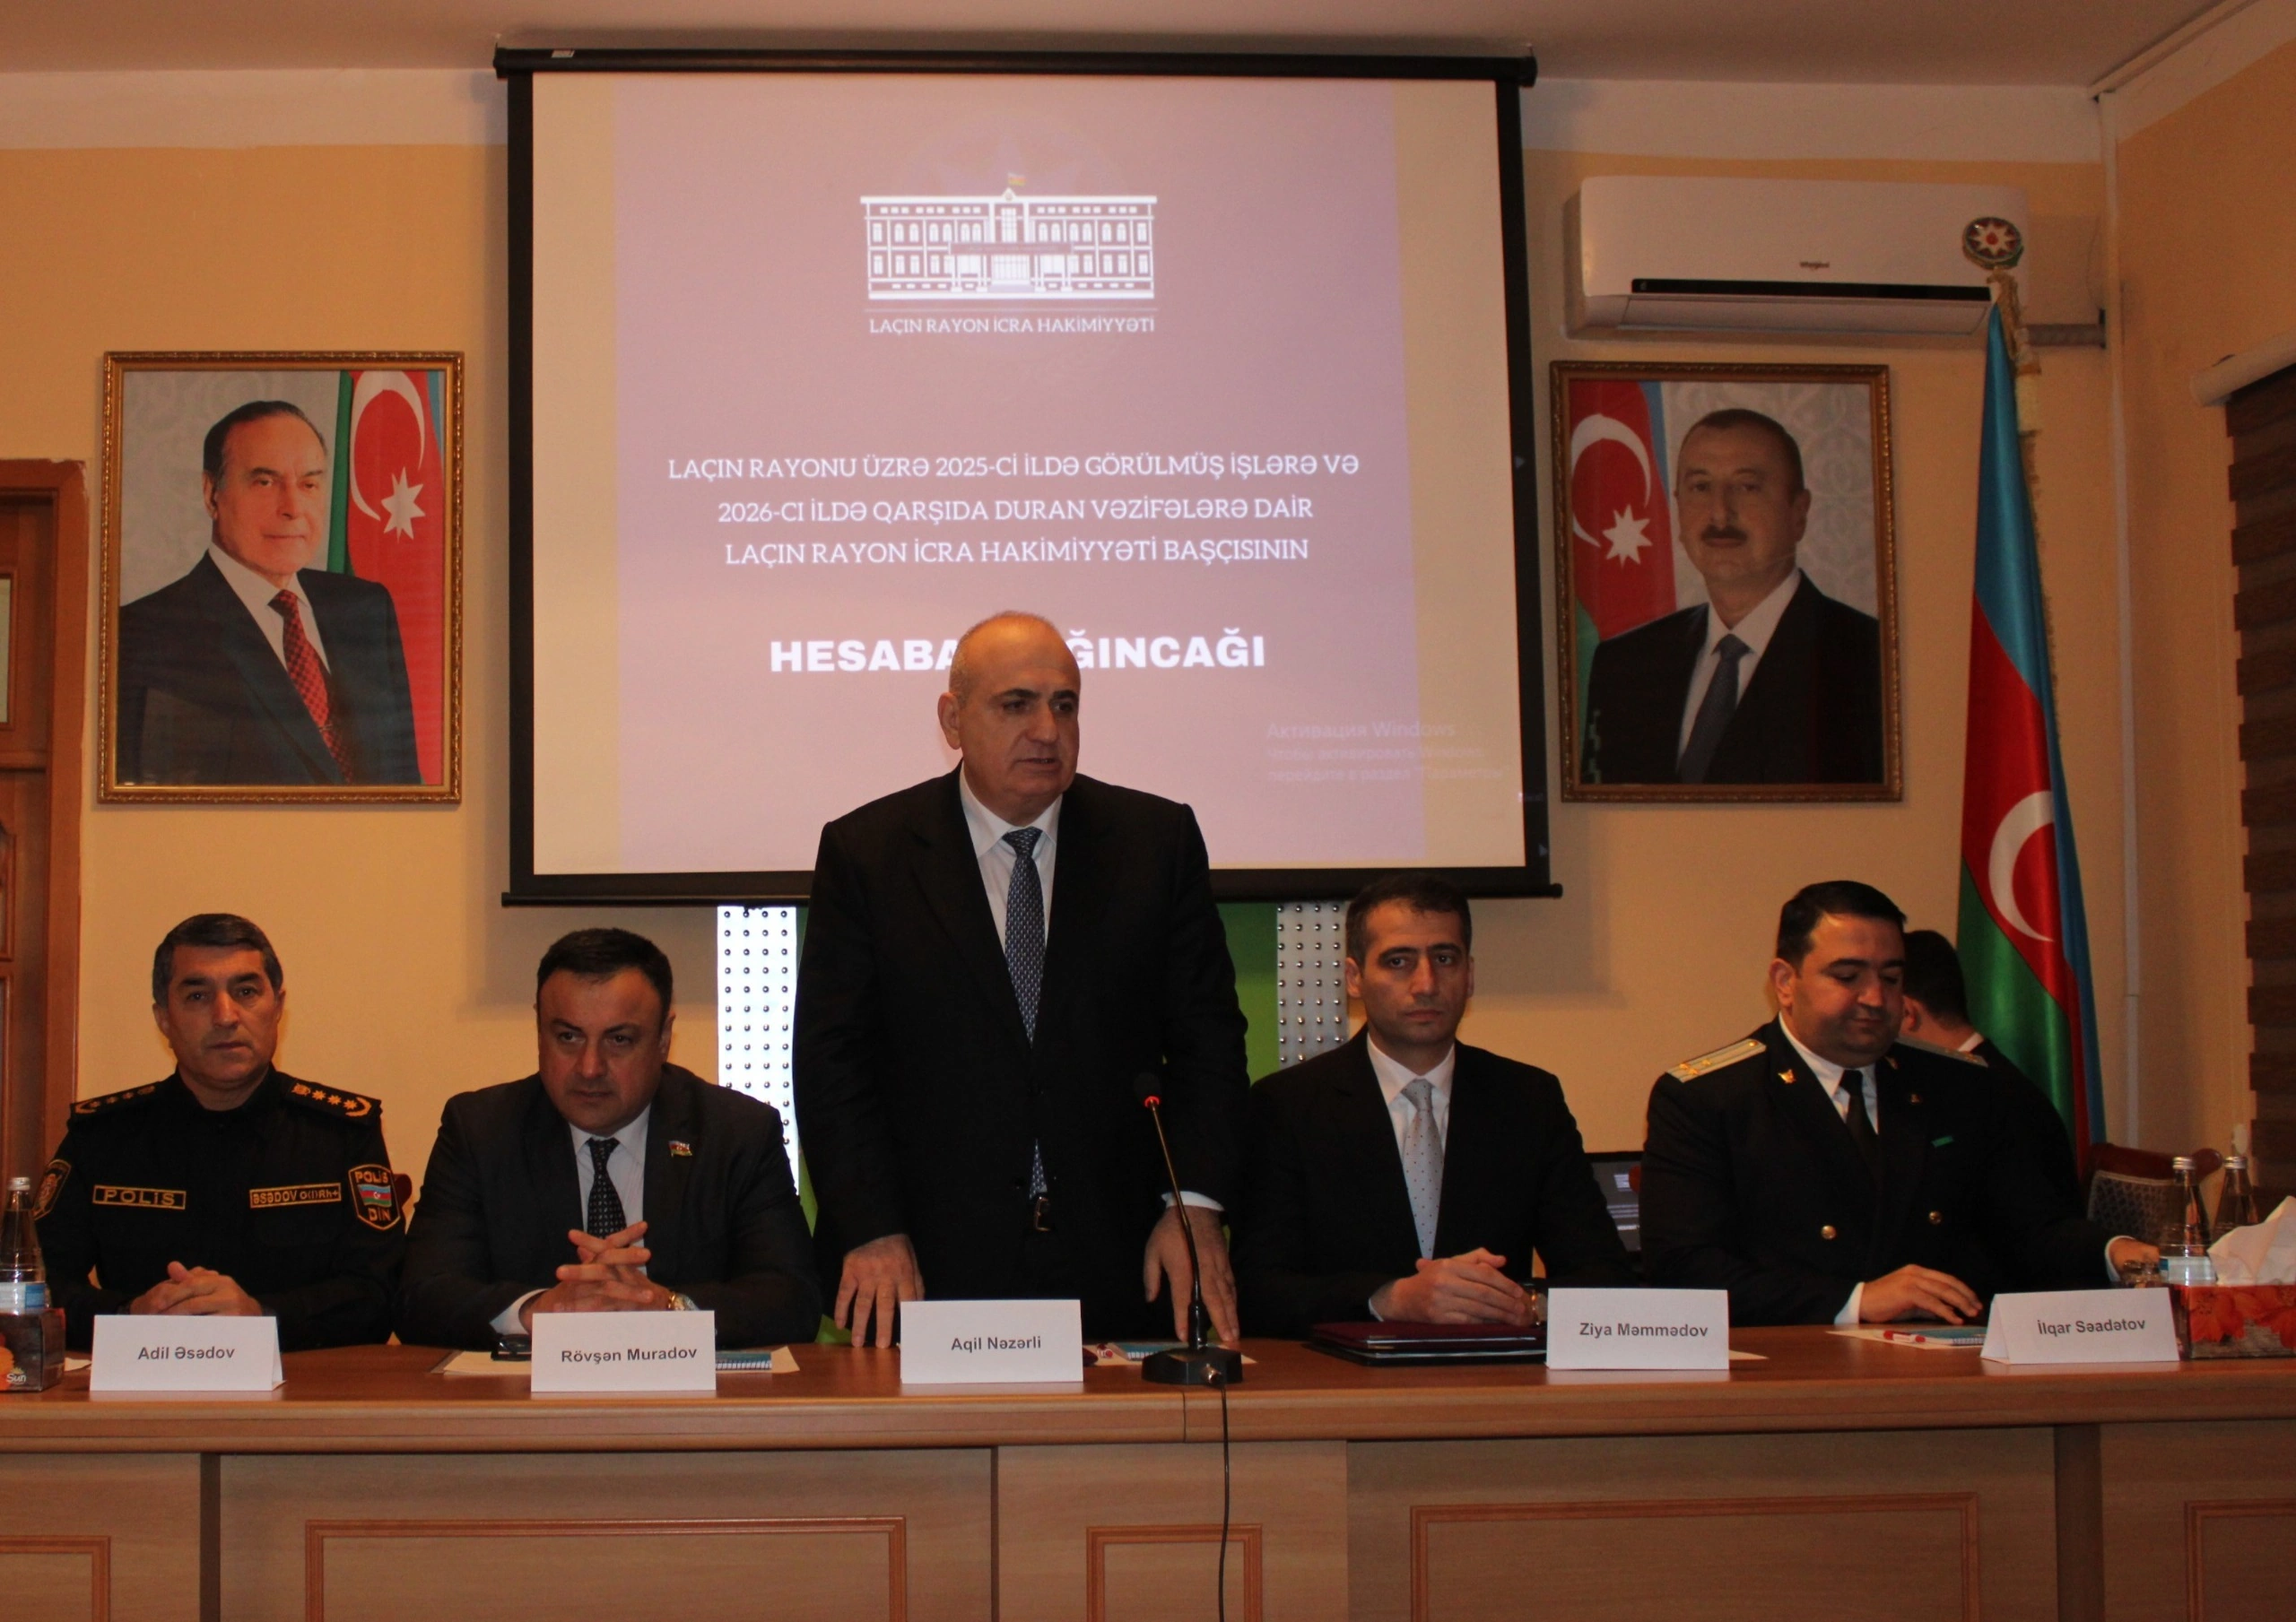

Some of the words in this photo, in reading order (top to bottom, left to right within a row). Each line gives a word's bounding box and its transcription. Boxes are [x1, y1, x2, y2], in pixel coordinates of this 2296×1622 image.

[869, 318, 921, 335] LAÇIN
[926, 318, 989, 334] RAYON
[993, 316, 1034, 333] İCRA
[1037, 315, 1155, 333] HAKİMİYYƏTİ
[668, 458, 744, 482] LAÇIN
[749, 457, 857, 478] RAYONU
[863, 454, 930, 477] ÜZRƏ
[935, 452, 1018, 477] 2025-Cİ
[1024, 452, 1080, 476] İLDƏ
[1084, 451, 1225, 481] GÖRÜLMÜŞ
[1231, 451, 1318, 480] İŞLƏRƏ
[1323, 454, 1361, 475] VƏ
[718, 501, 804, 523] 2026-CI
[811, 498, 867, 522] İLDƏ
[873, 500, 988, 525] QARŞIDA
[995, 499, 1085, 520] DURAN
[1090, 495, 1248, 520] VƏZİFƏLƏRƏ
[1254, 494, 1314, 518] DAİR
[726, 543, 805, 568] LAÇIN
[812, 542, 908, 564] RAYON
[914, 538, 974, 563] İCRA
[980, 535, 1157, 562] HAKİMİYYƏTİ
[1163, 539, 1309, 566] BAŞÇISININ
[770, 639, 957, 672] HESABA
[1065, 628, 1266, 670] ĞINCAĞI
[1579, 1322, 1613, 1340] Ziya
[1617, 1323, 1709, 1337] Məmmədov
[2075, 1318, 2145, 1333] Səadətov
[137, 1346, 170, 1360] Adil
[174, 1346, 235, 1360] Əsədov
[951, 1336, 982, 1354] Aqil
[987, 1335, 1041, 1349] Nəzərli
[561, 1349, 622, 1365] Rövşən
[627, 1346, 698, 1361] Muradov
